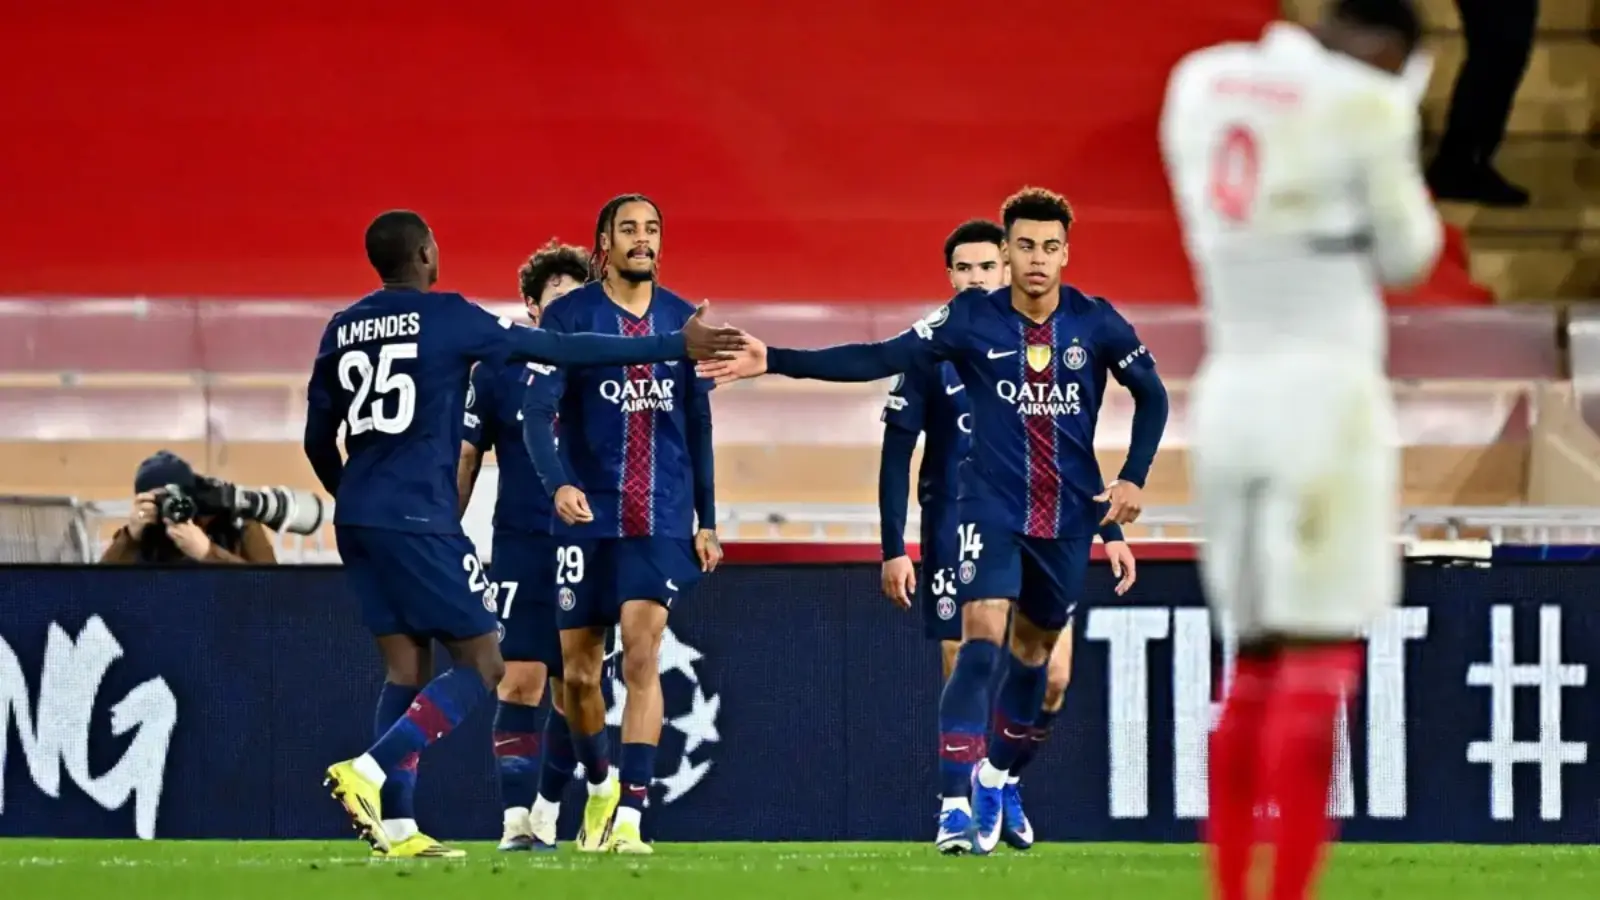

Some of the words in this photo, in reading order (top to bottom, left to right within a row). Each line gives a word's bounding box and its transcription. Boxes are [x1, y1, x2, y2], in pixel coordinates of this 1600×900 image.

[337, 312, 420, 349] N.MENDES
[338, 343, 418, 436] 25
[599, 378, 675, 404] QATAR
[996, 379, 1080, 404] QATAR
[1016, 402, 1081, 415] AIRWAYS
[957, 522, 984, 562] 14
[463, 553, 490, 593] 2
[556, 545, 584, 585] 29
[1086, 606, 1429, 819] THT
